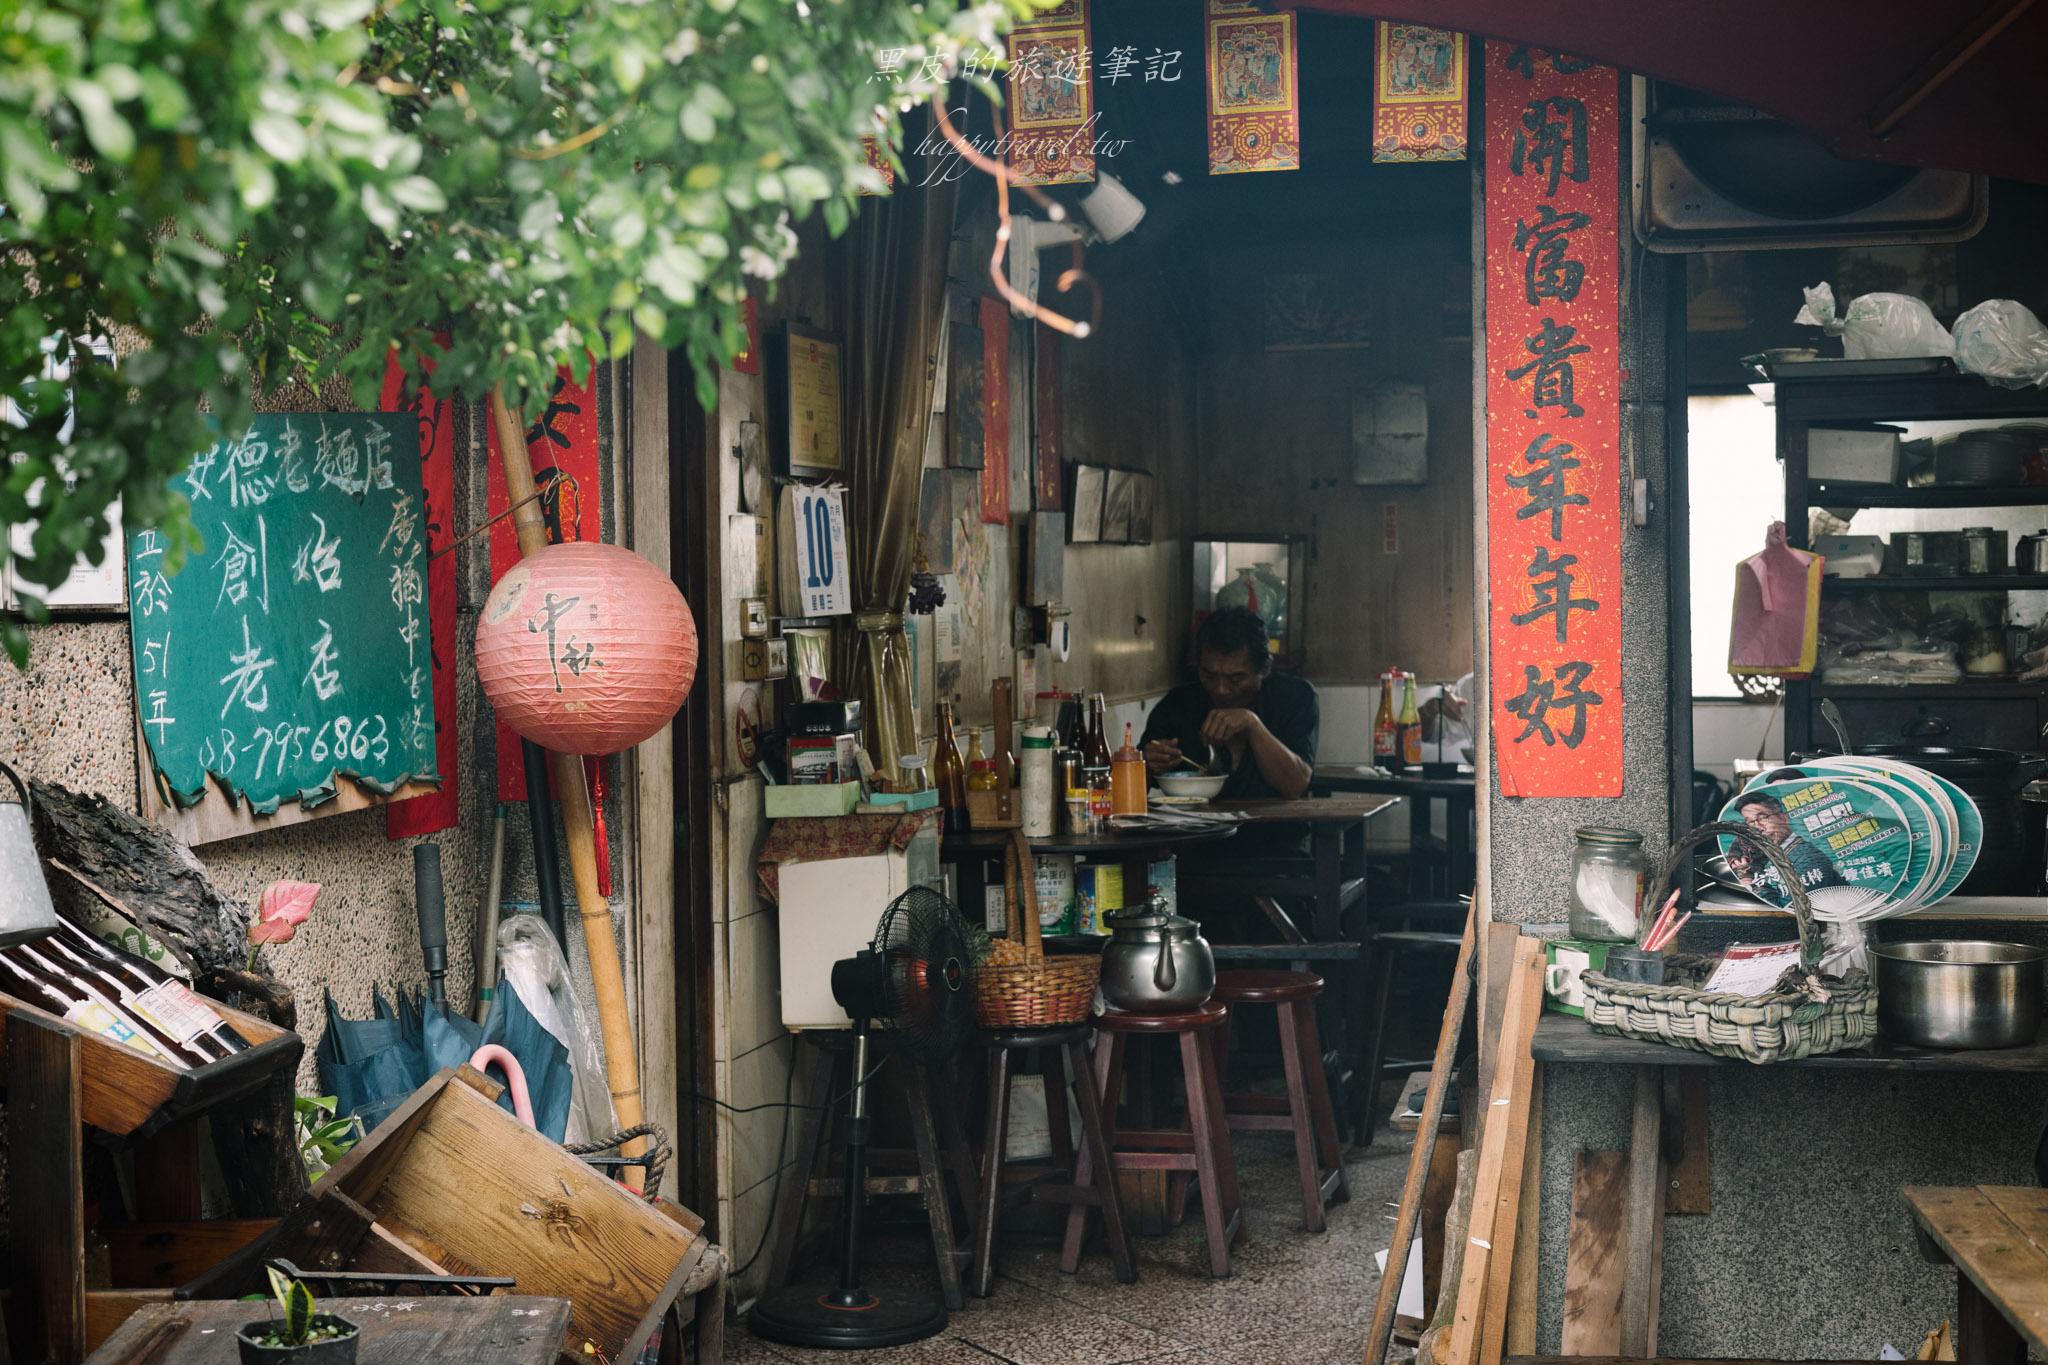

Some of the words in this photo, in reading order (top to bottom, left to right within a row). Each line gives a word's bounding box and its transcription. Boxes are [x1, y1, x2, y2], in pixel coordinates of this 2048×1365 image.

[210, 512, 342, 615] 創始
[803, 496, 834, 588] 10
[220, 614, 345, 721] 老店
[528, 592, 605, 694] 中秋
[199, 713, 390, 780] 08-7956863
